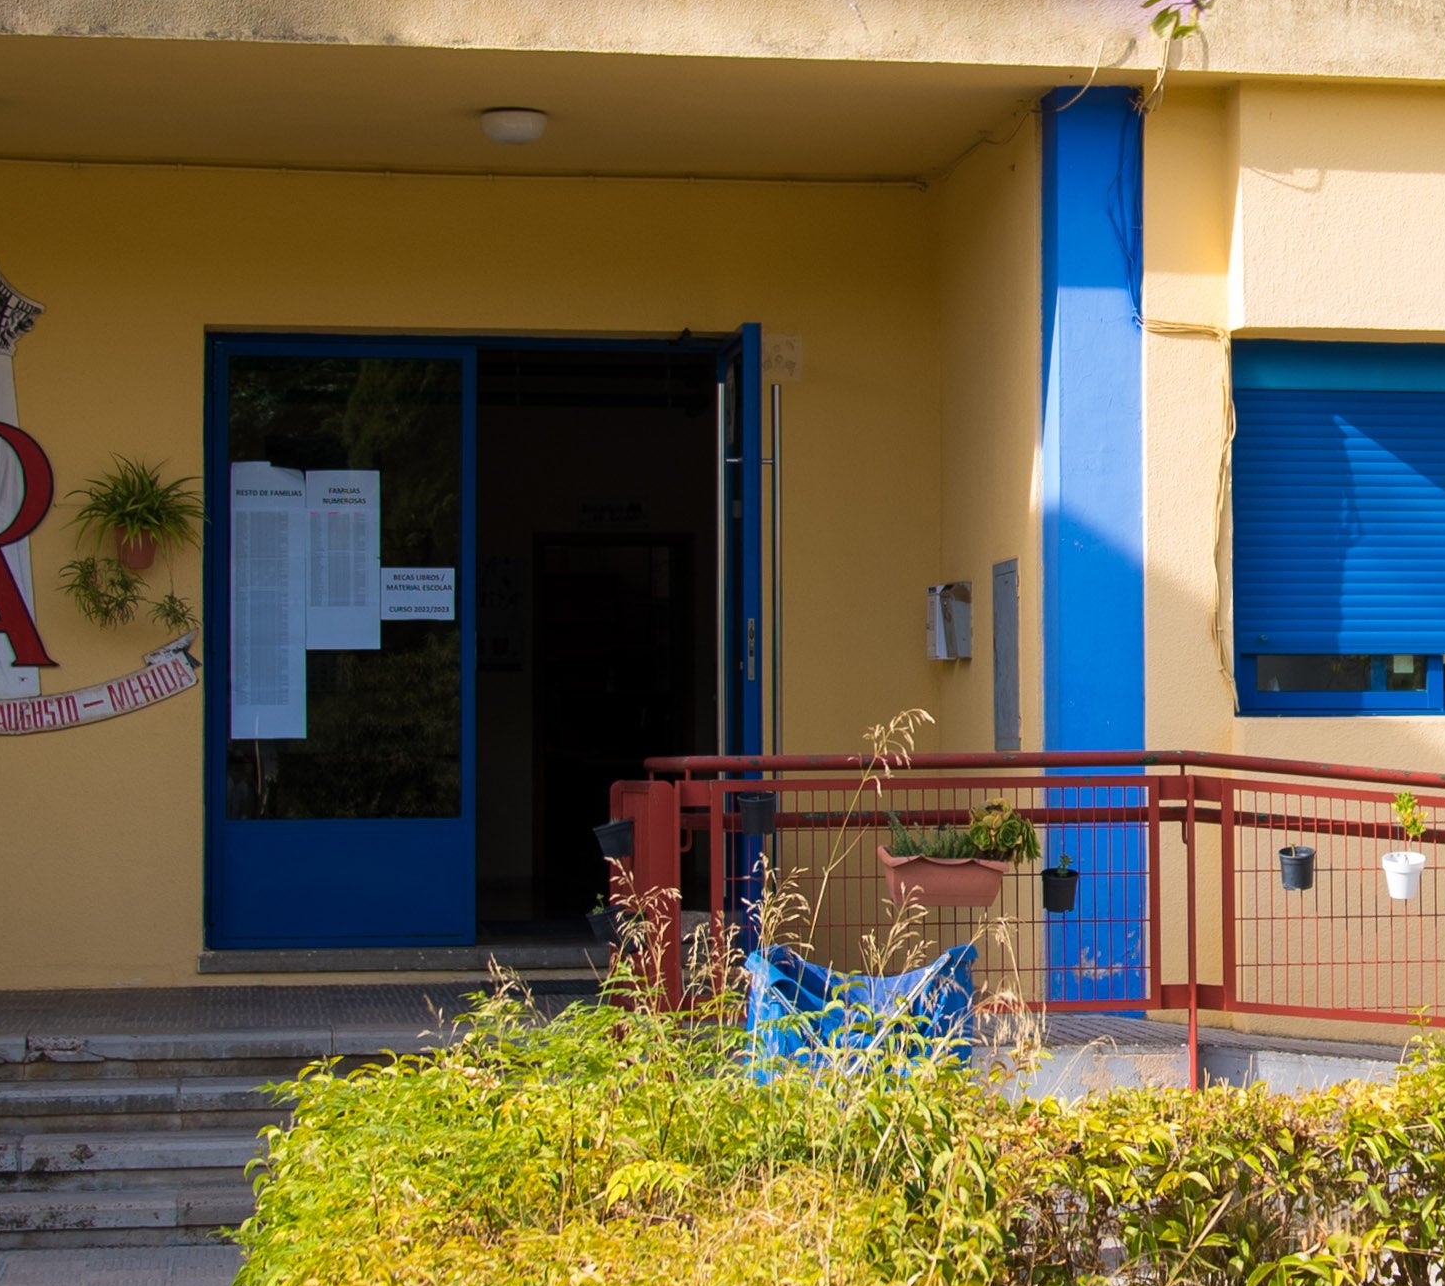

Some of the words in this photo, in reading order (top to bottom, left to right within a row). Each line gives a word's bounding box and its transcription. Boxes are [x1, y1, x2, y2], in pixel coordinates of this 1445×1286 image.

[236, 489, 258, 497] RESTO
[259, 489, 269, 497] DE
[270, 489, 303, 497] FAMILIAS
[328, 487, 361, 495] FAMILIAS
[322, 497, 367, 505] NUMEROSAS
[416, 574, 440, 582] LIBROS
[386, 584, 421, 592] MATERIAL
[422, 584, 453, 592] ESCOLAR
[388, 605, 413, 613] CURSO
[414, 605, 450, 614] 2022/2023
[107, 657, 193, 712] MERIDA
